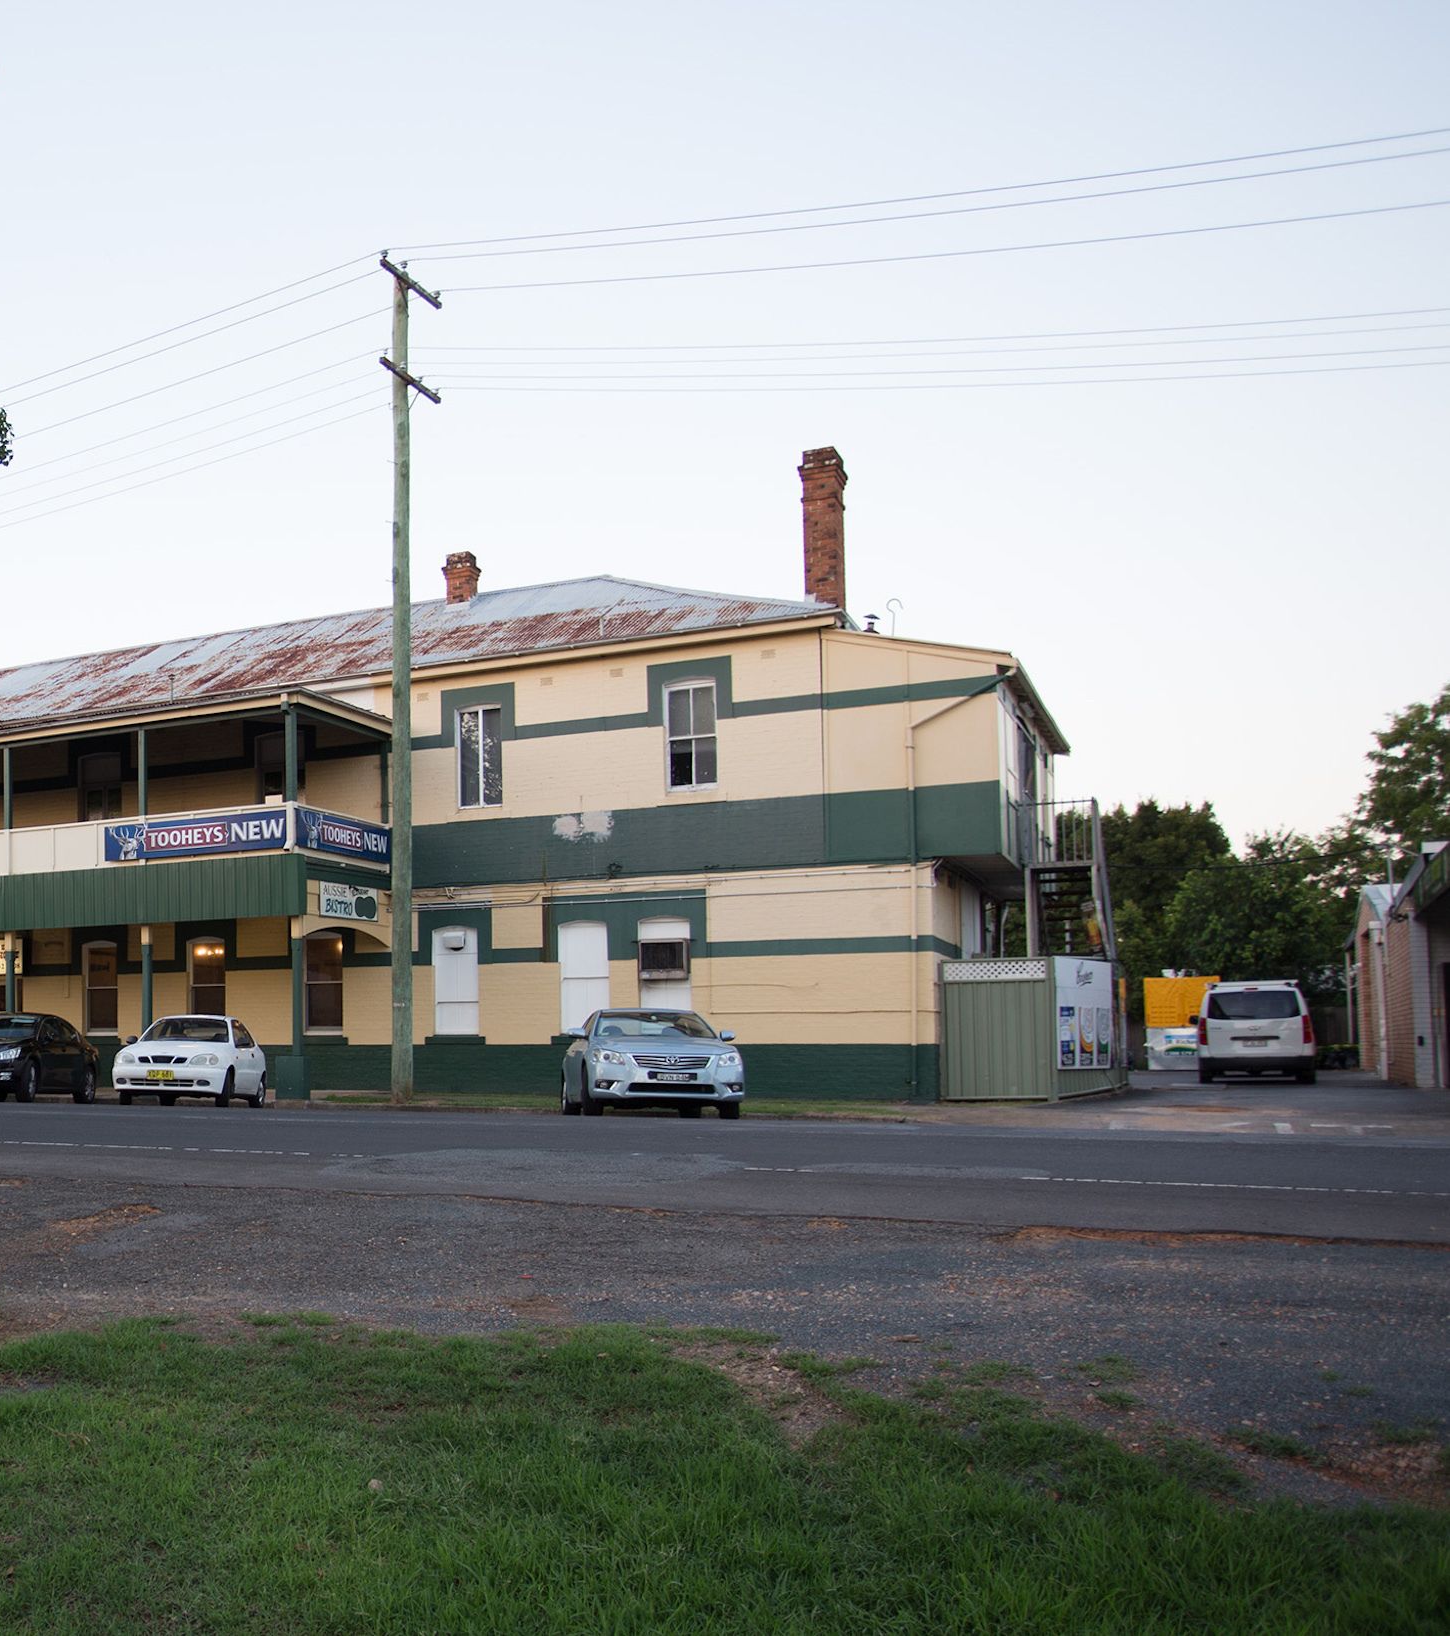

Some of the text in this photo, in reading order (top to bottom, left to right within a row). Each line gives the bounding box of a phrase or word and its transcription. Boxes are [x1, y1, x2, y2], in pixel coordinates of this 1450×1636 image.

[147, 818, 284, 848] TOOHEYS NEW
[322, 824, 388, 854] TOOHEYS NEW
[323, 884, 348, 898] AUSSIE
[325, 898, 353, 916] BISTRO
